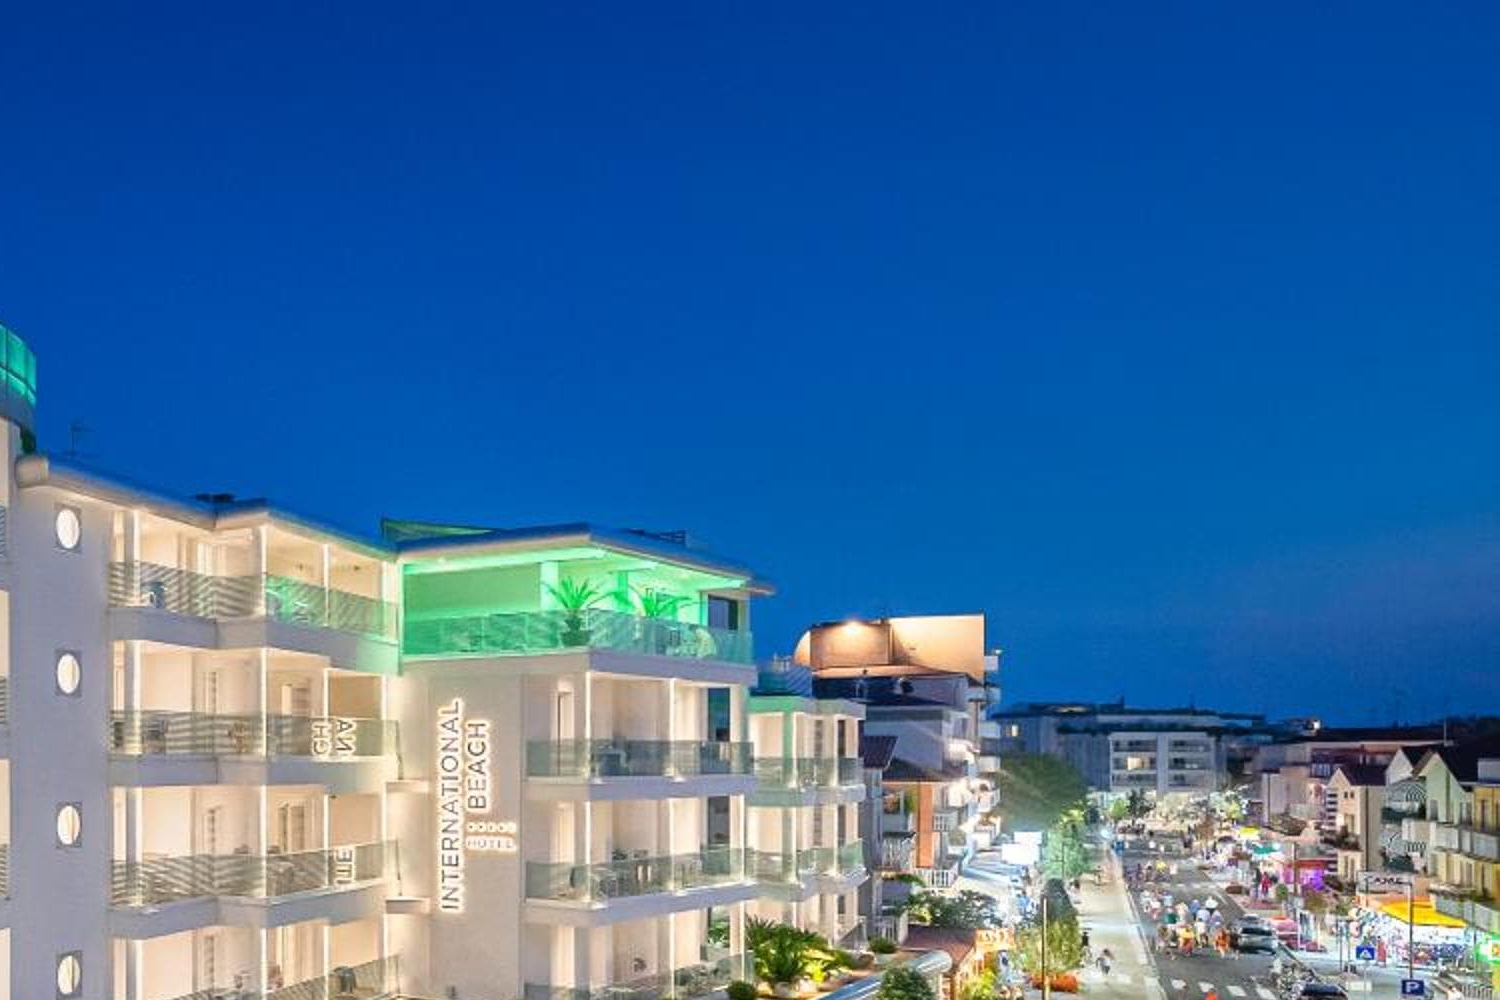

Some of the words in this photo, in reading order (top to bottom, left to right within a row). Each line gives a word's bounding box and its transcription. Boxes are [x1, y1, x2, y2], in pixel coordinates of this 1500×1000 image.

[440, 700, 460, 911] INTERNATIONAL
[467, 722, 487, 809] BEACH
[1405, 981, 1420, 993] P
